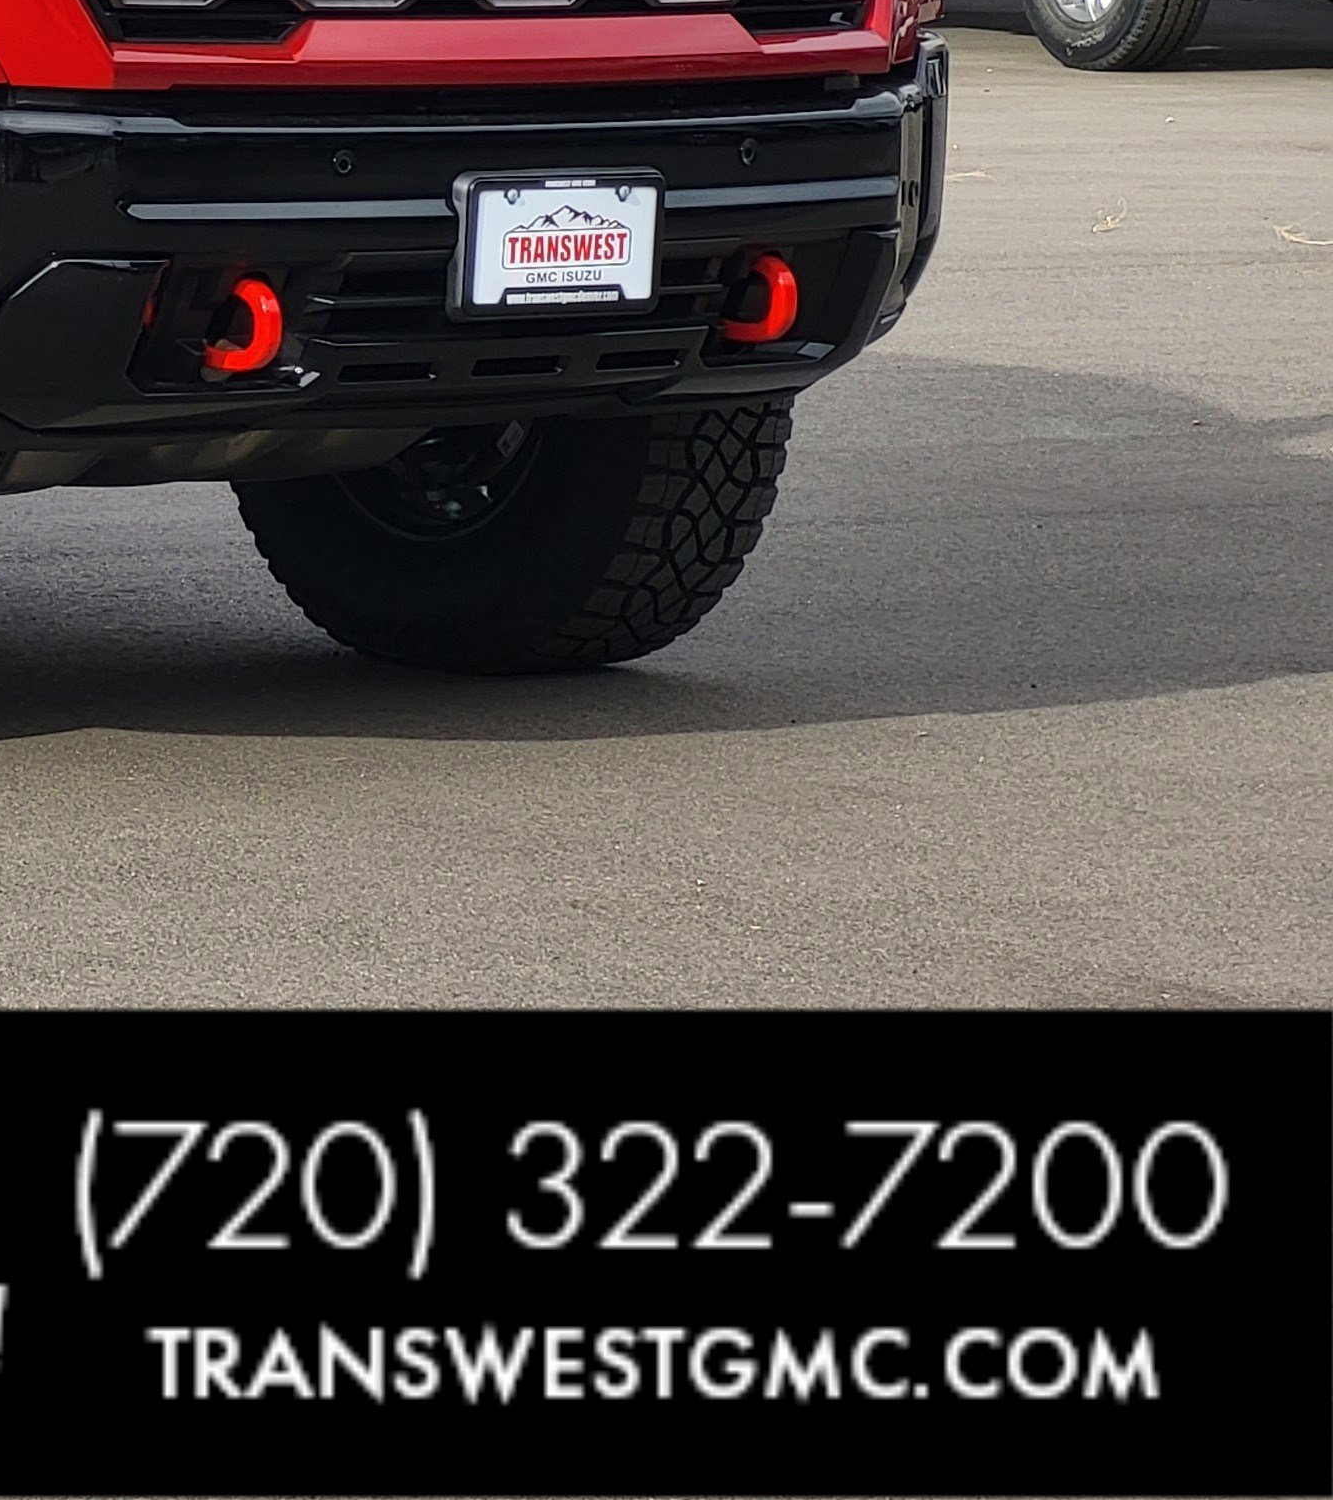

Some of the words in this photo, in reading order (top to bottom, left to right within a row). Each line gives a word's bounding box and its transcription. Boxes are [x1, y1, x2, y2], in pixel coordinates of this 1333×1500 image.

[508, 233, 628, 264] TRANSWEST
[526, 271, 558, 284] GMC
[562, 270, 602, 283] ISUZU
